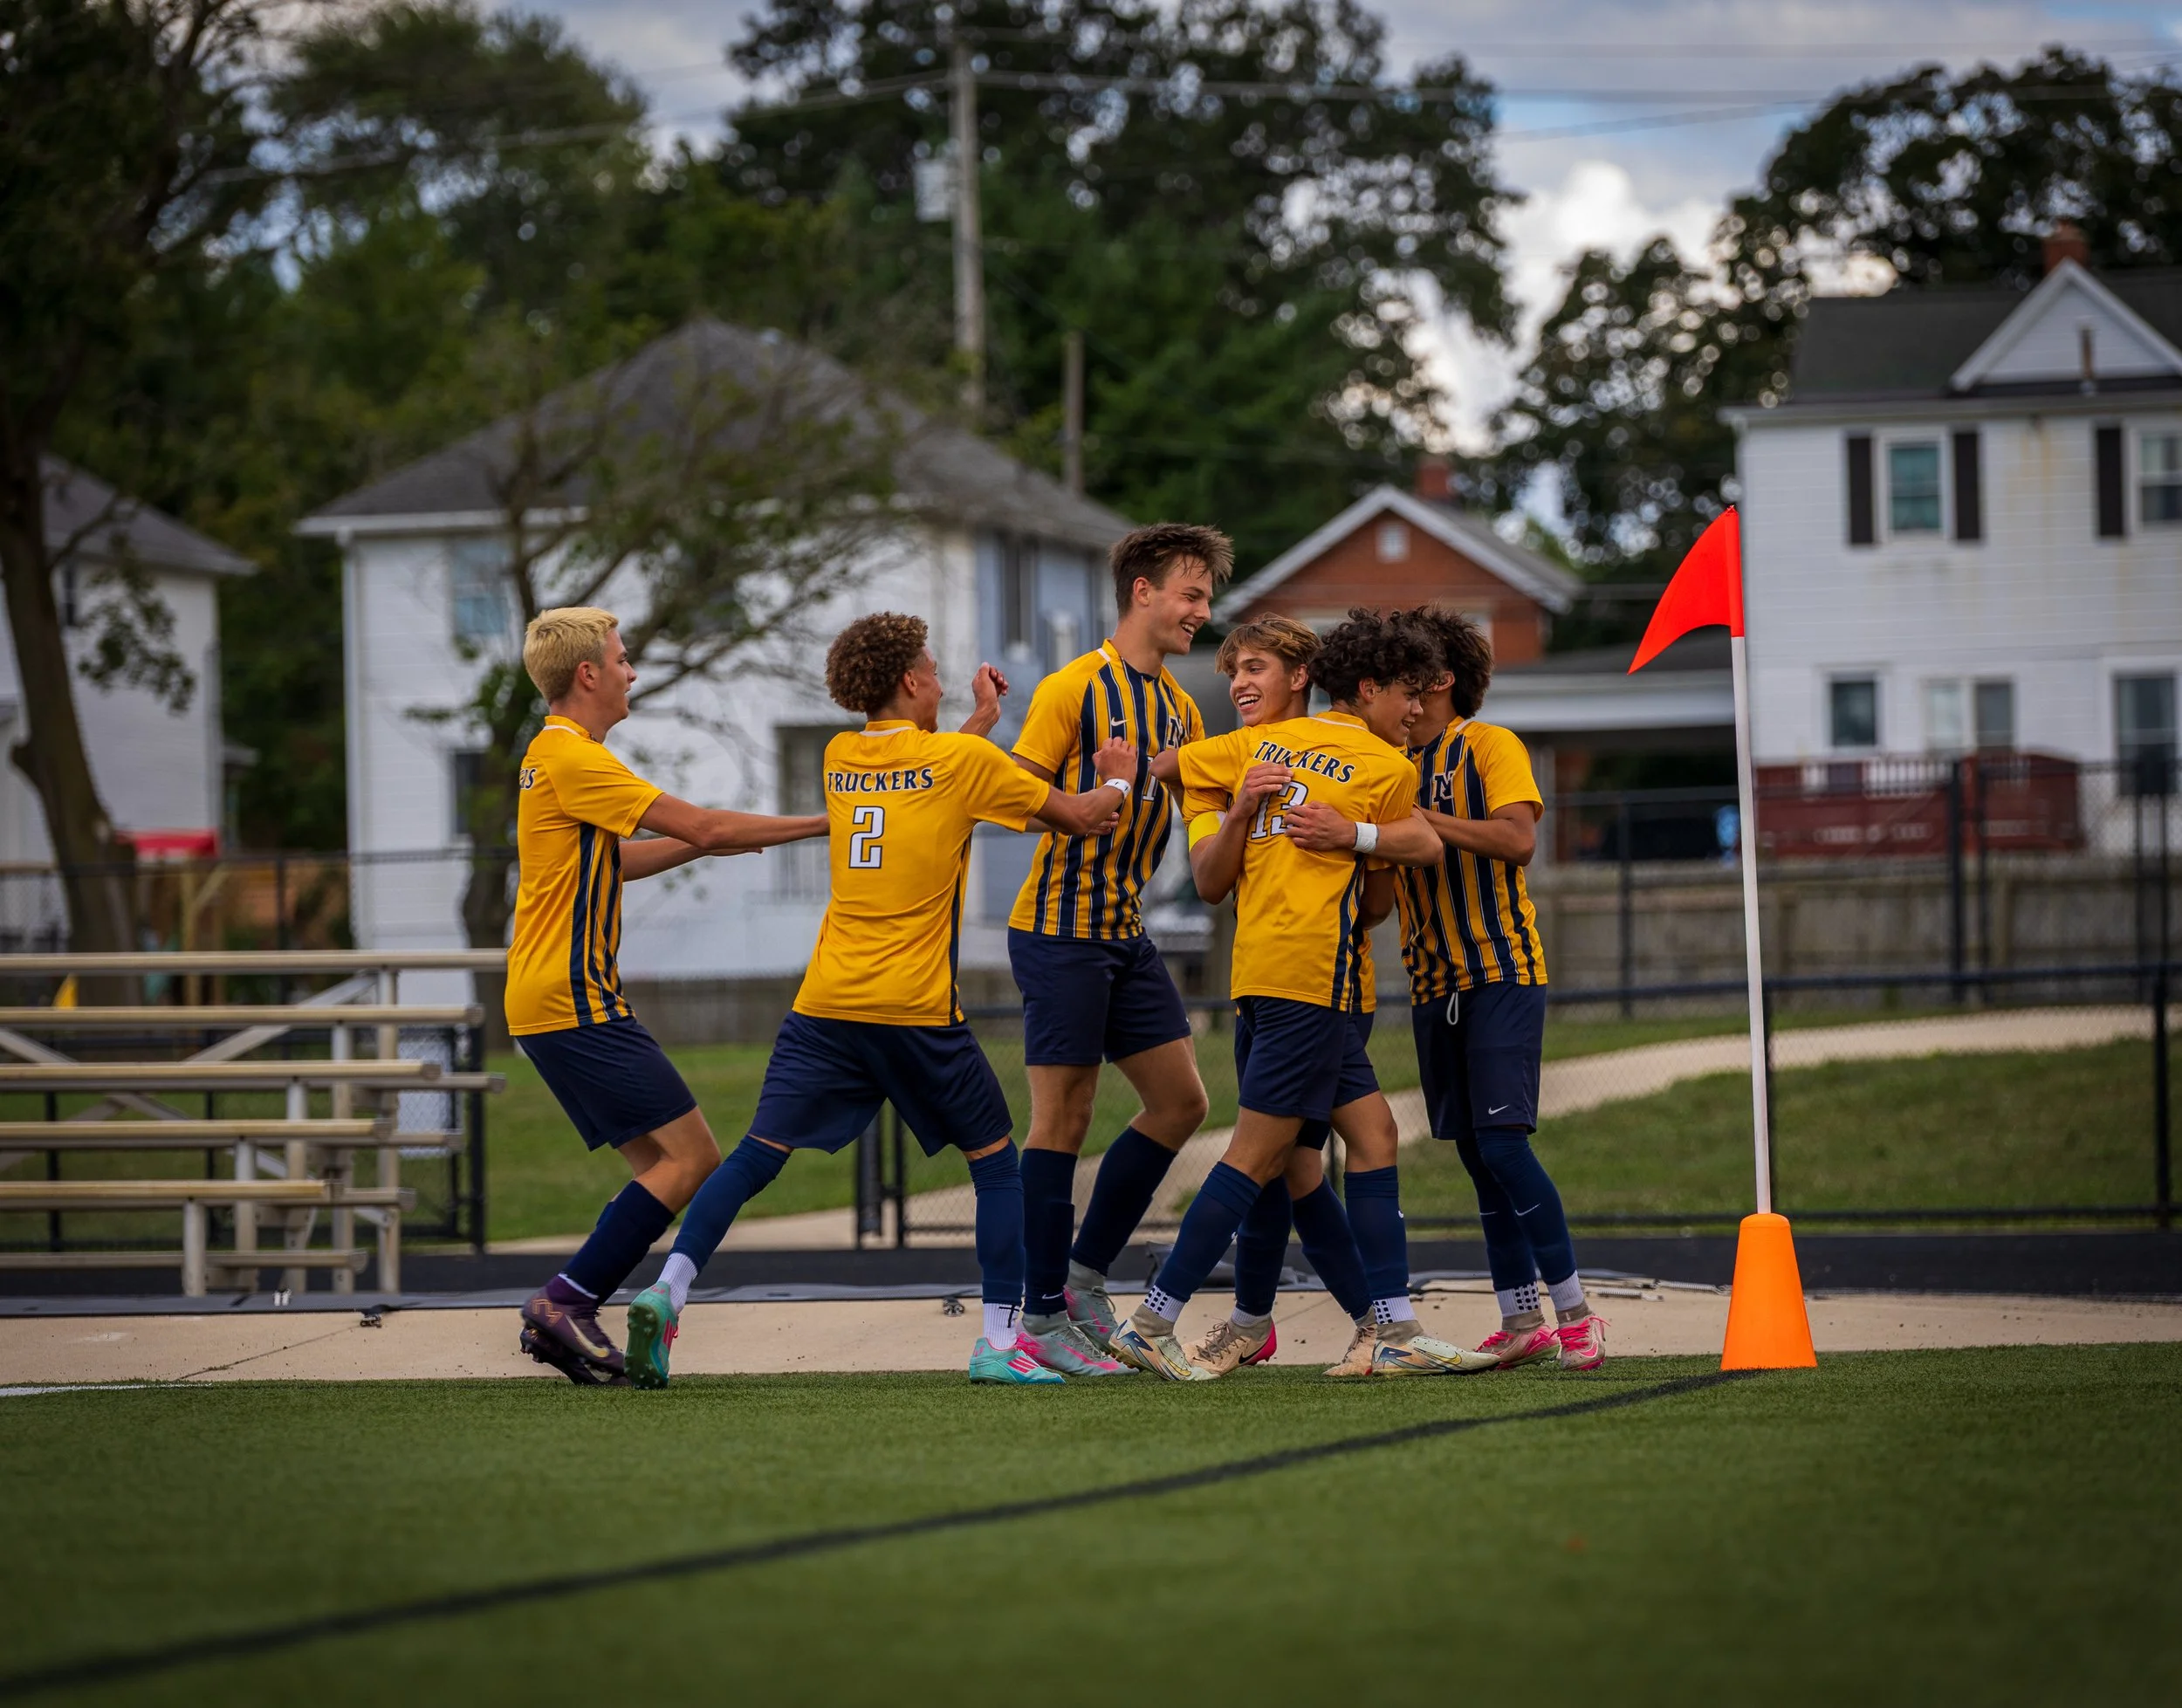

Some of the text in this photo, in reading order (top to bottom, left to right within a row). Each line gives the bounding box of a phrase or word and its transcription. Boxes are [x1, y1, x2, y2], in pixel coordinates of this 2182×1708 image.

[827, 768, 935, 792] TRUCKERS
[1254, 740, 1355, 784] TRUCKERS
[848, 805, 885, 869] 2
